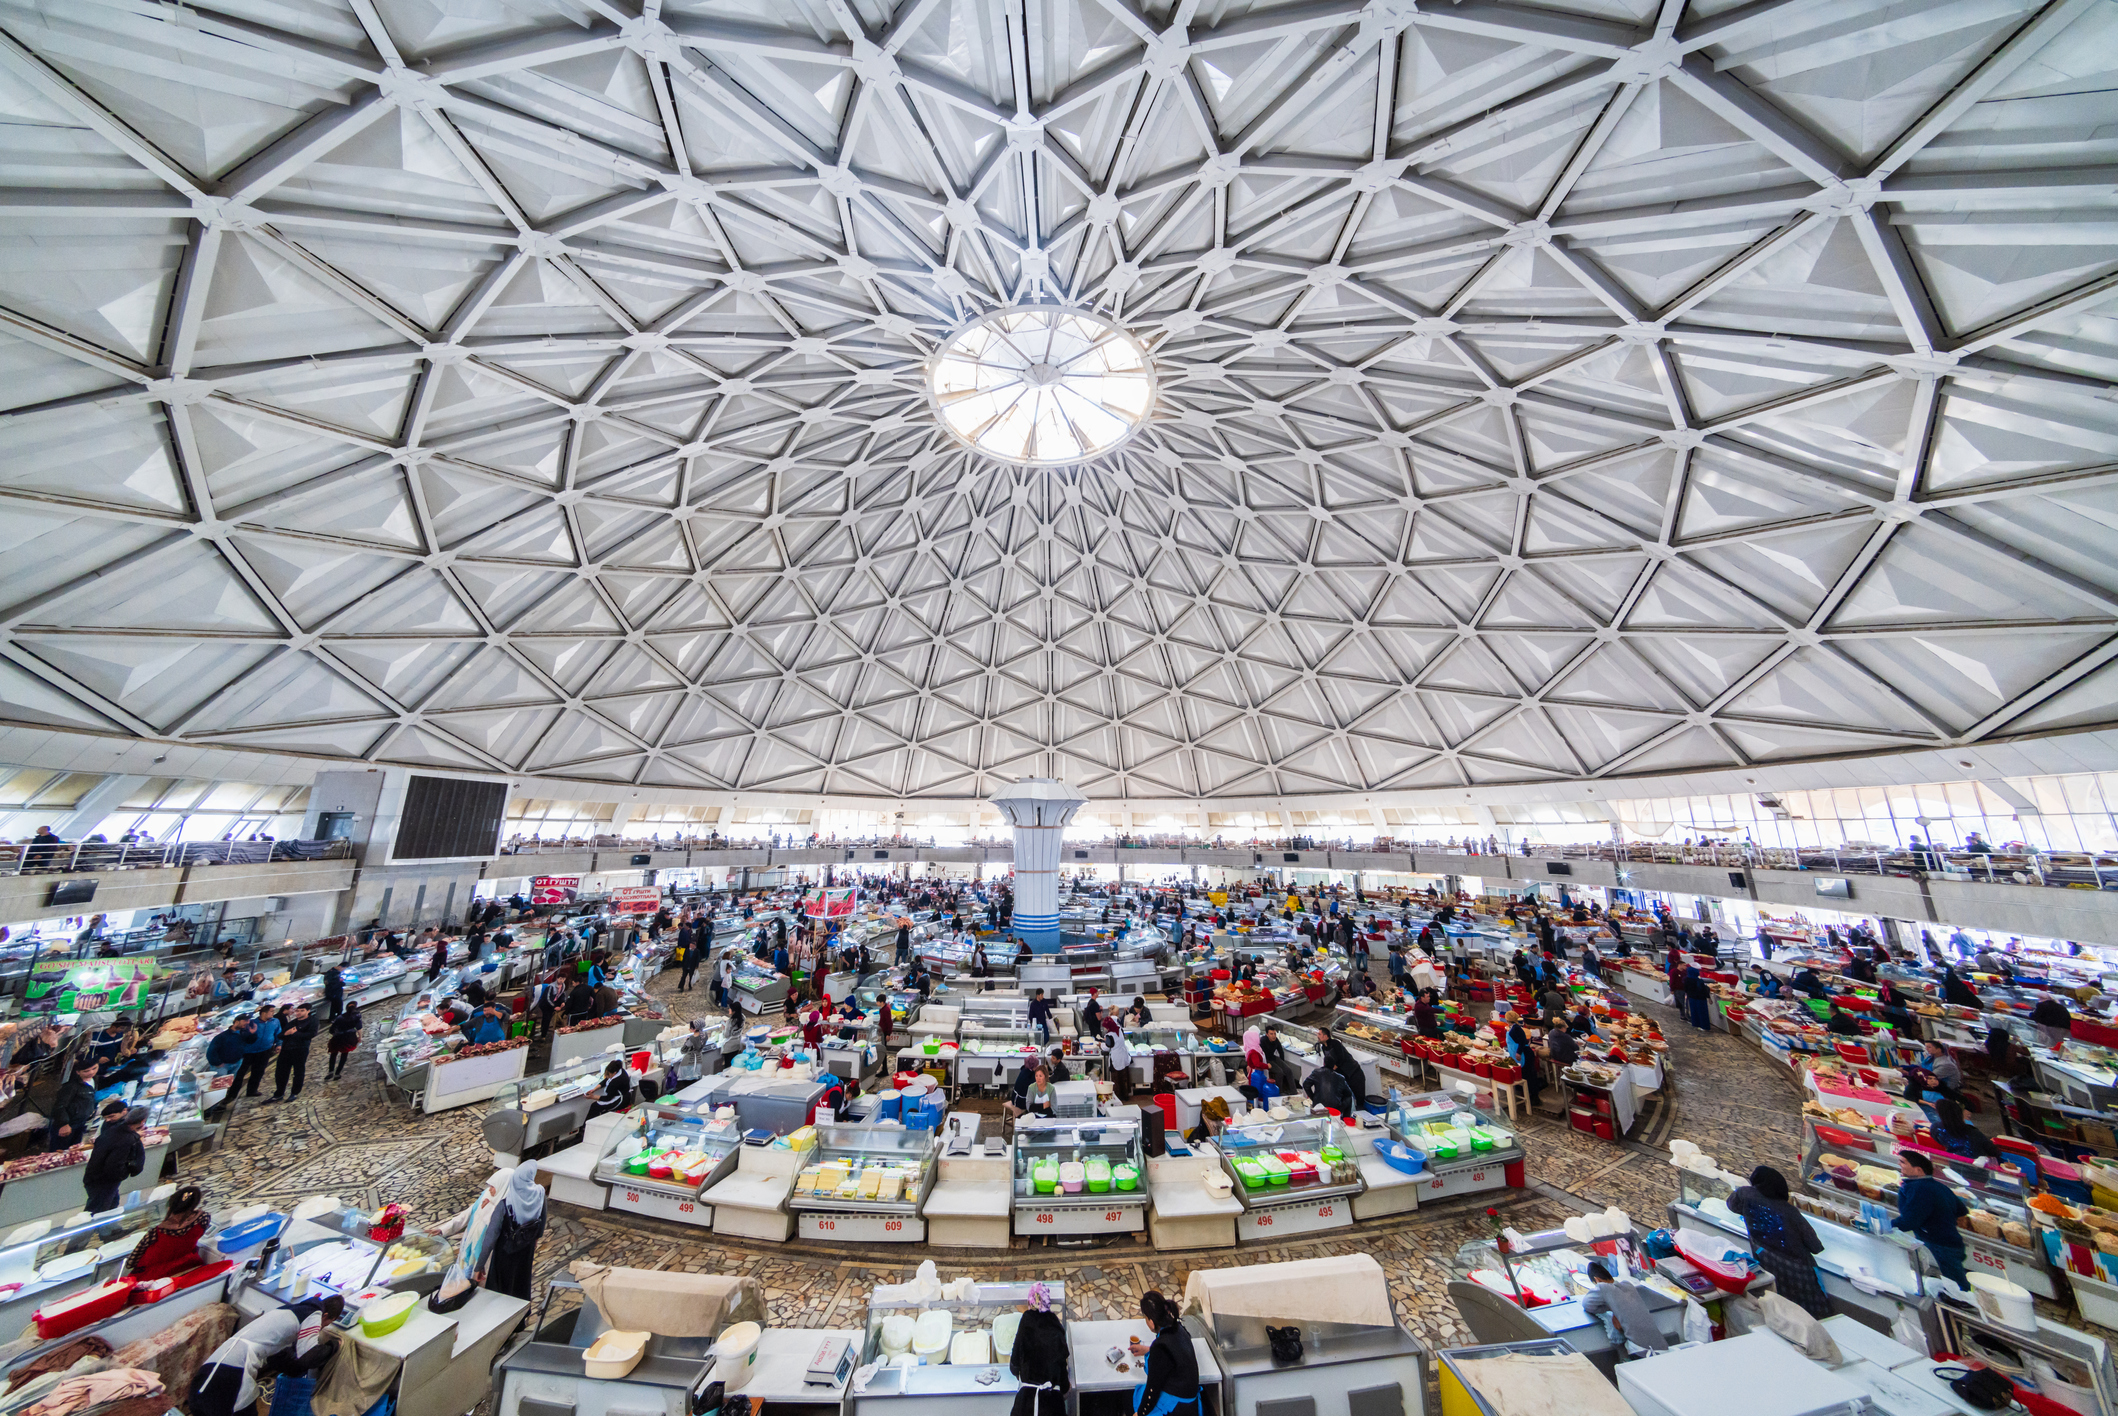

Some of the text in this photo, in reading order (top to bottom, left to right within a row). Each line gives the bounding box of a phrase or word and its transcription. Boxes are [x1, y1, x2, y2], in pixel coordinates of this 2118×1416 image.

[1472, 1172, 1485, 1182] 493
[1431, 1179, 1444, 1189] 494
[626, 1192, 639, 1203] 500
[679, 1203, 694, 1213] 499
[1318, 1206, 1333, 1218] 495
[1036, 1213, 1054, 1224] 498
[1105, 1211, 1122, 1222] 497
[1257, 1215, 1273, 1227] 496
[818, 1220, 835, 1231] 610
[885, 1221, 902, 1231] 609
[1972, 1251, 2006, 1270] 555
